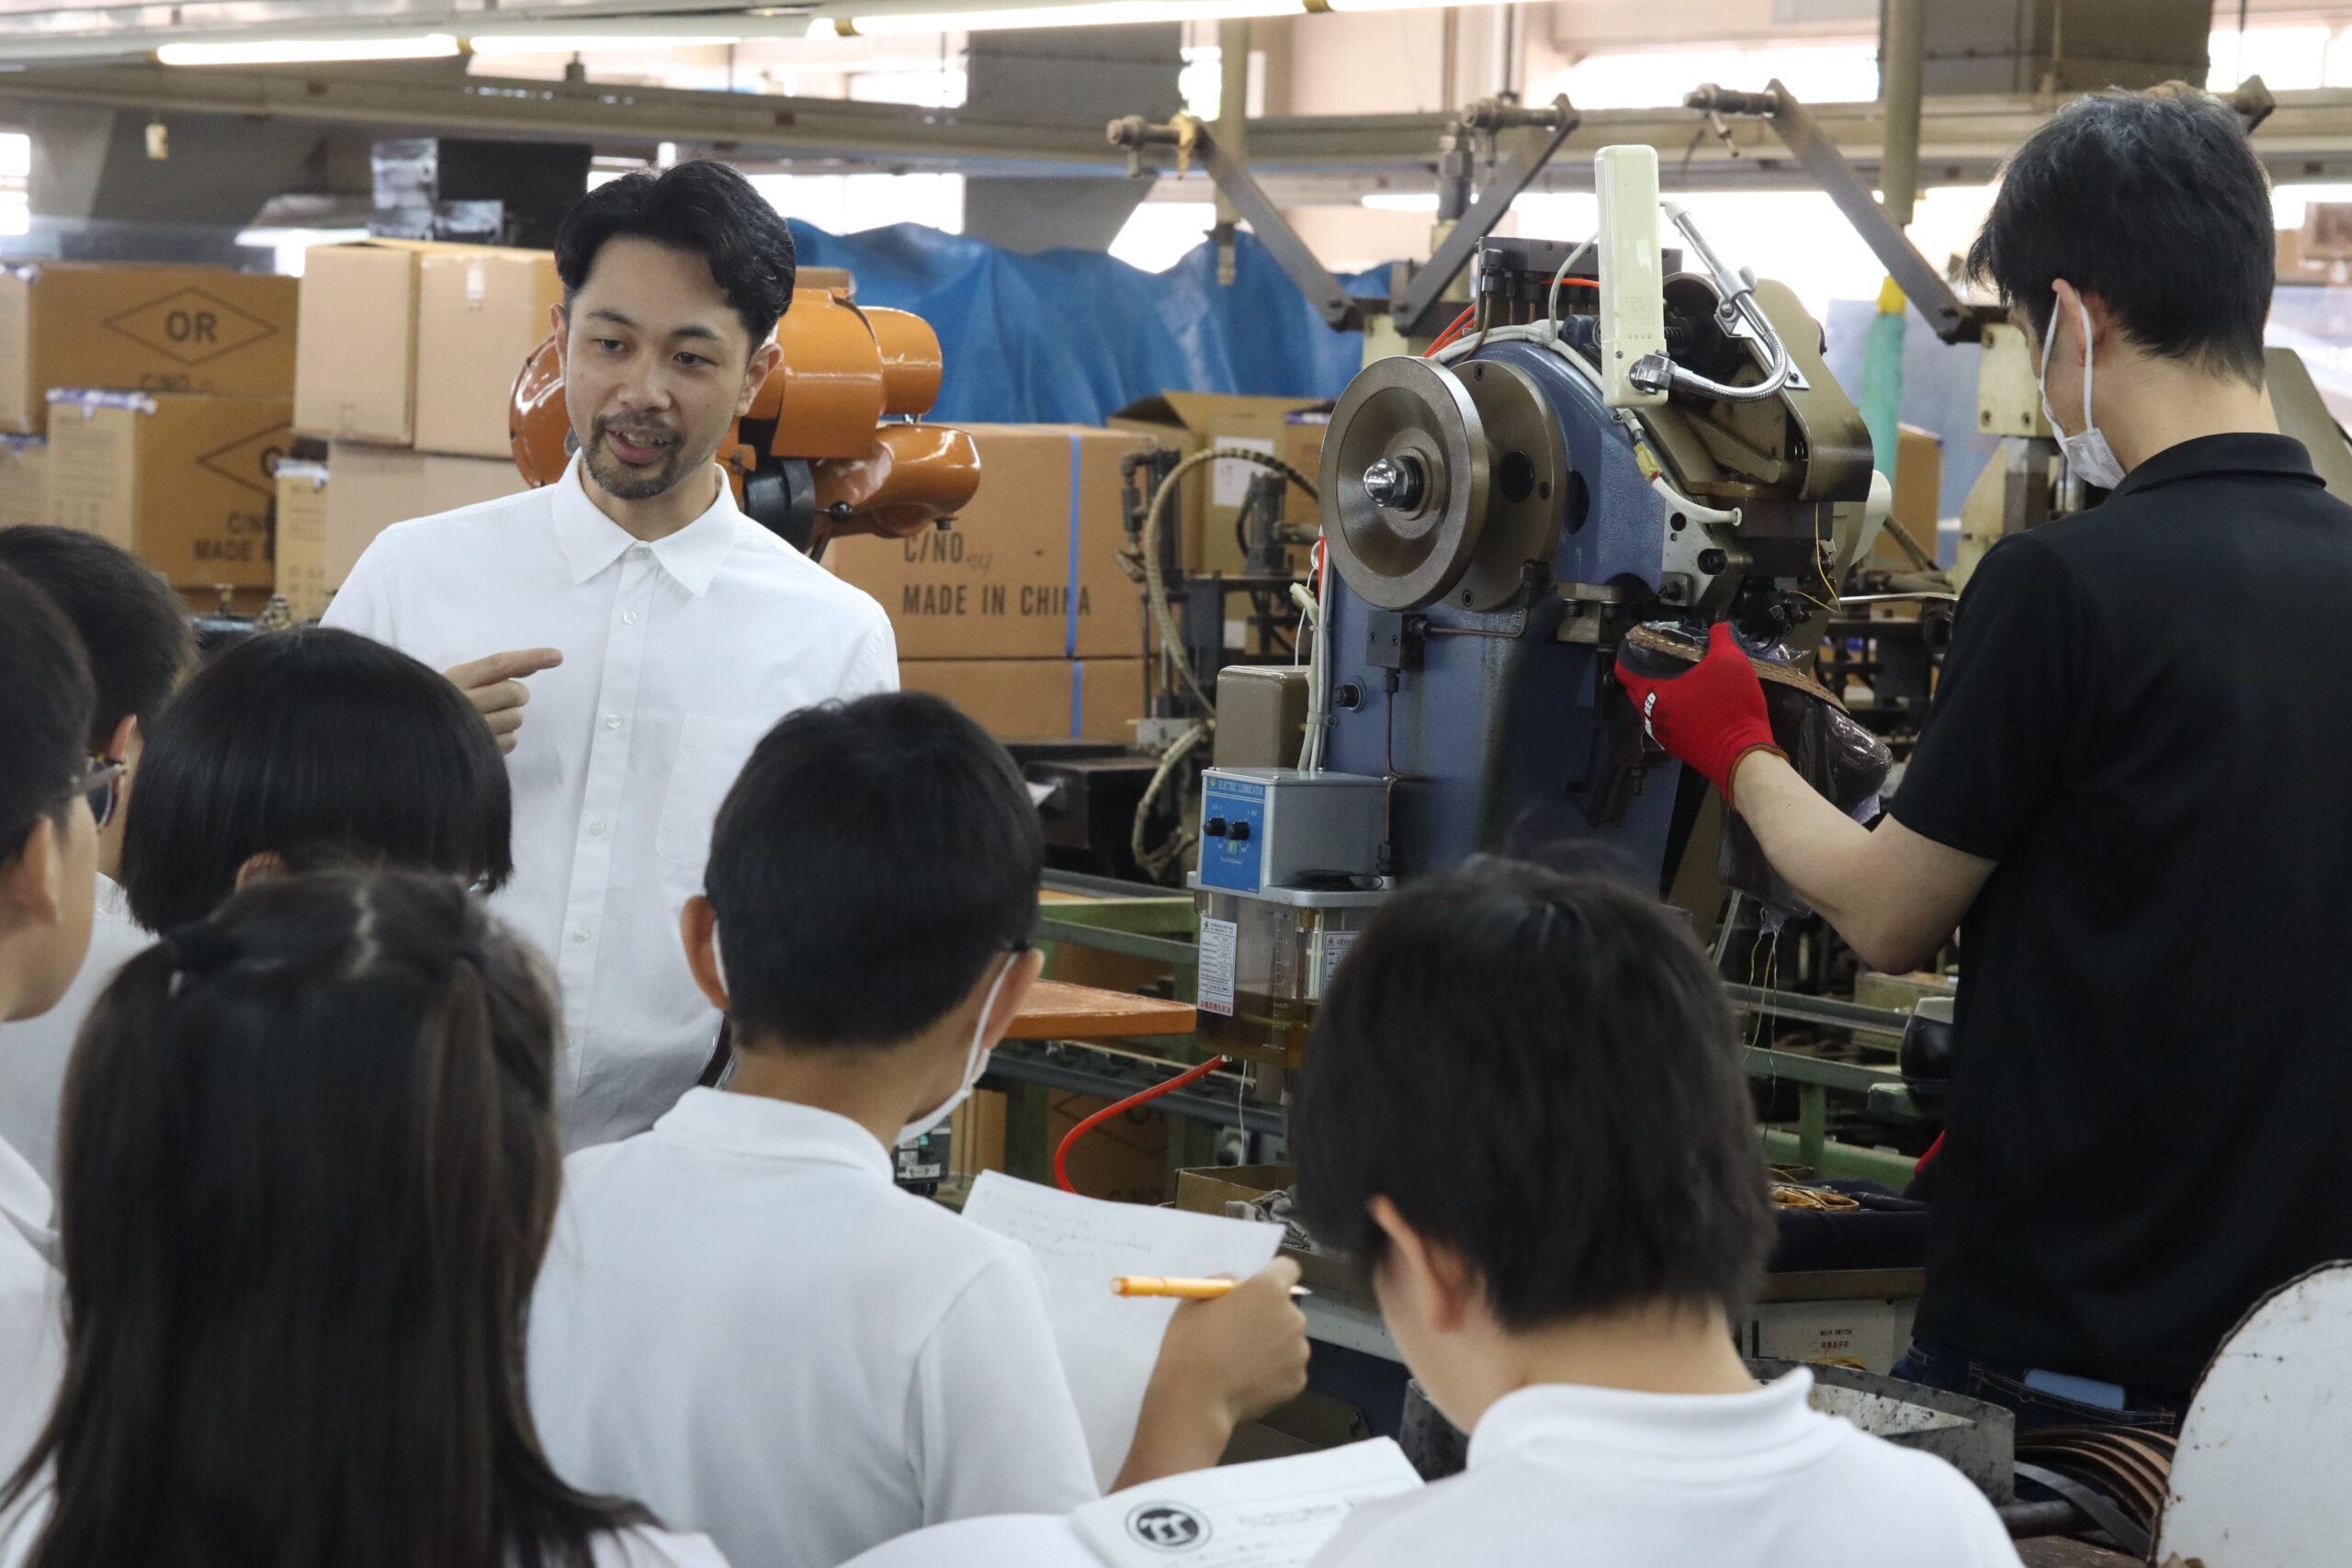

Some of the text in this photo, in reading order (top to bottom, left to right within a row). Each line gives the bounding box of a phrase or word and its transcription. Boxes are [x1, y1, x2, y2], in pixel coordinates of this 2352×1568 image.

[165, 309, 218, 343] OR
[261, 446, 285, 479] O
[193, 538, 253, 562] MADE
[903, 584, 967, 615] MADE
[982, 585, 1005, 615] IN
[1218, 779, 1264, 796] ELECTRIC LUBRICATOR
